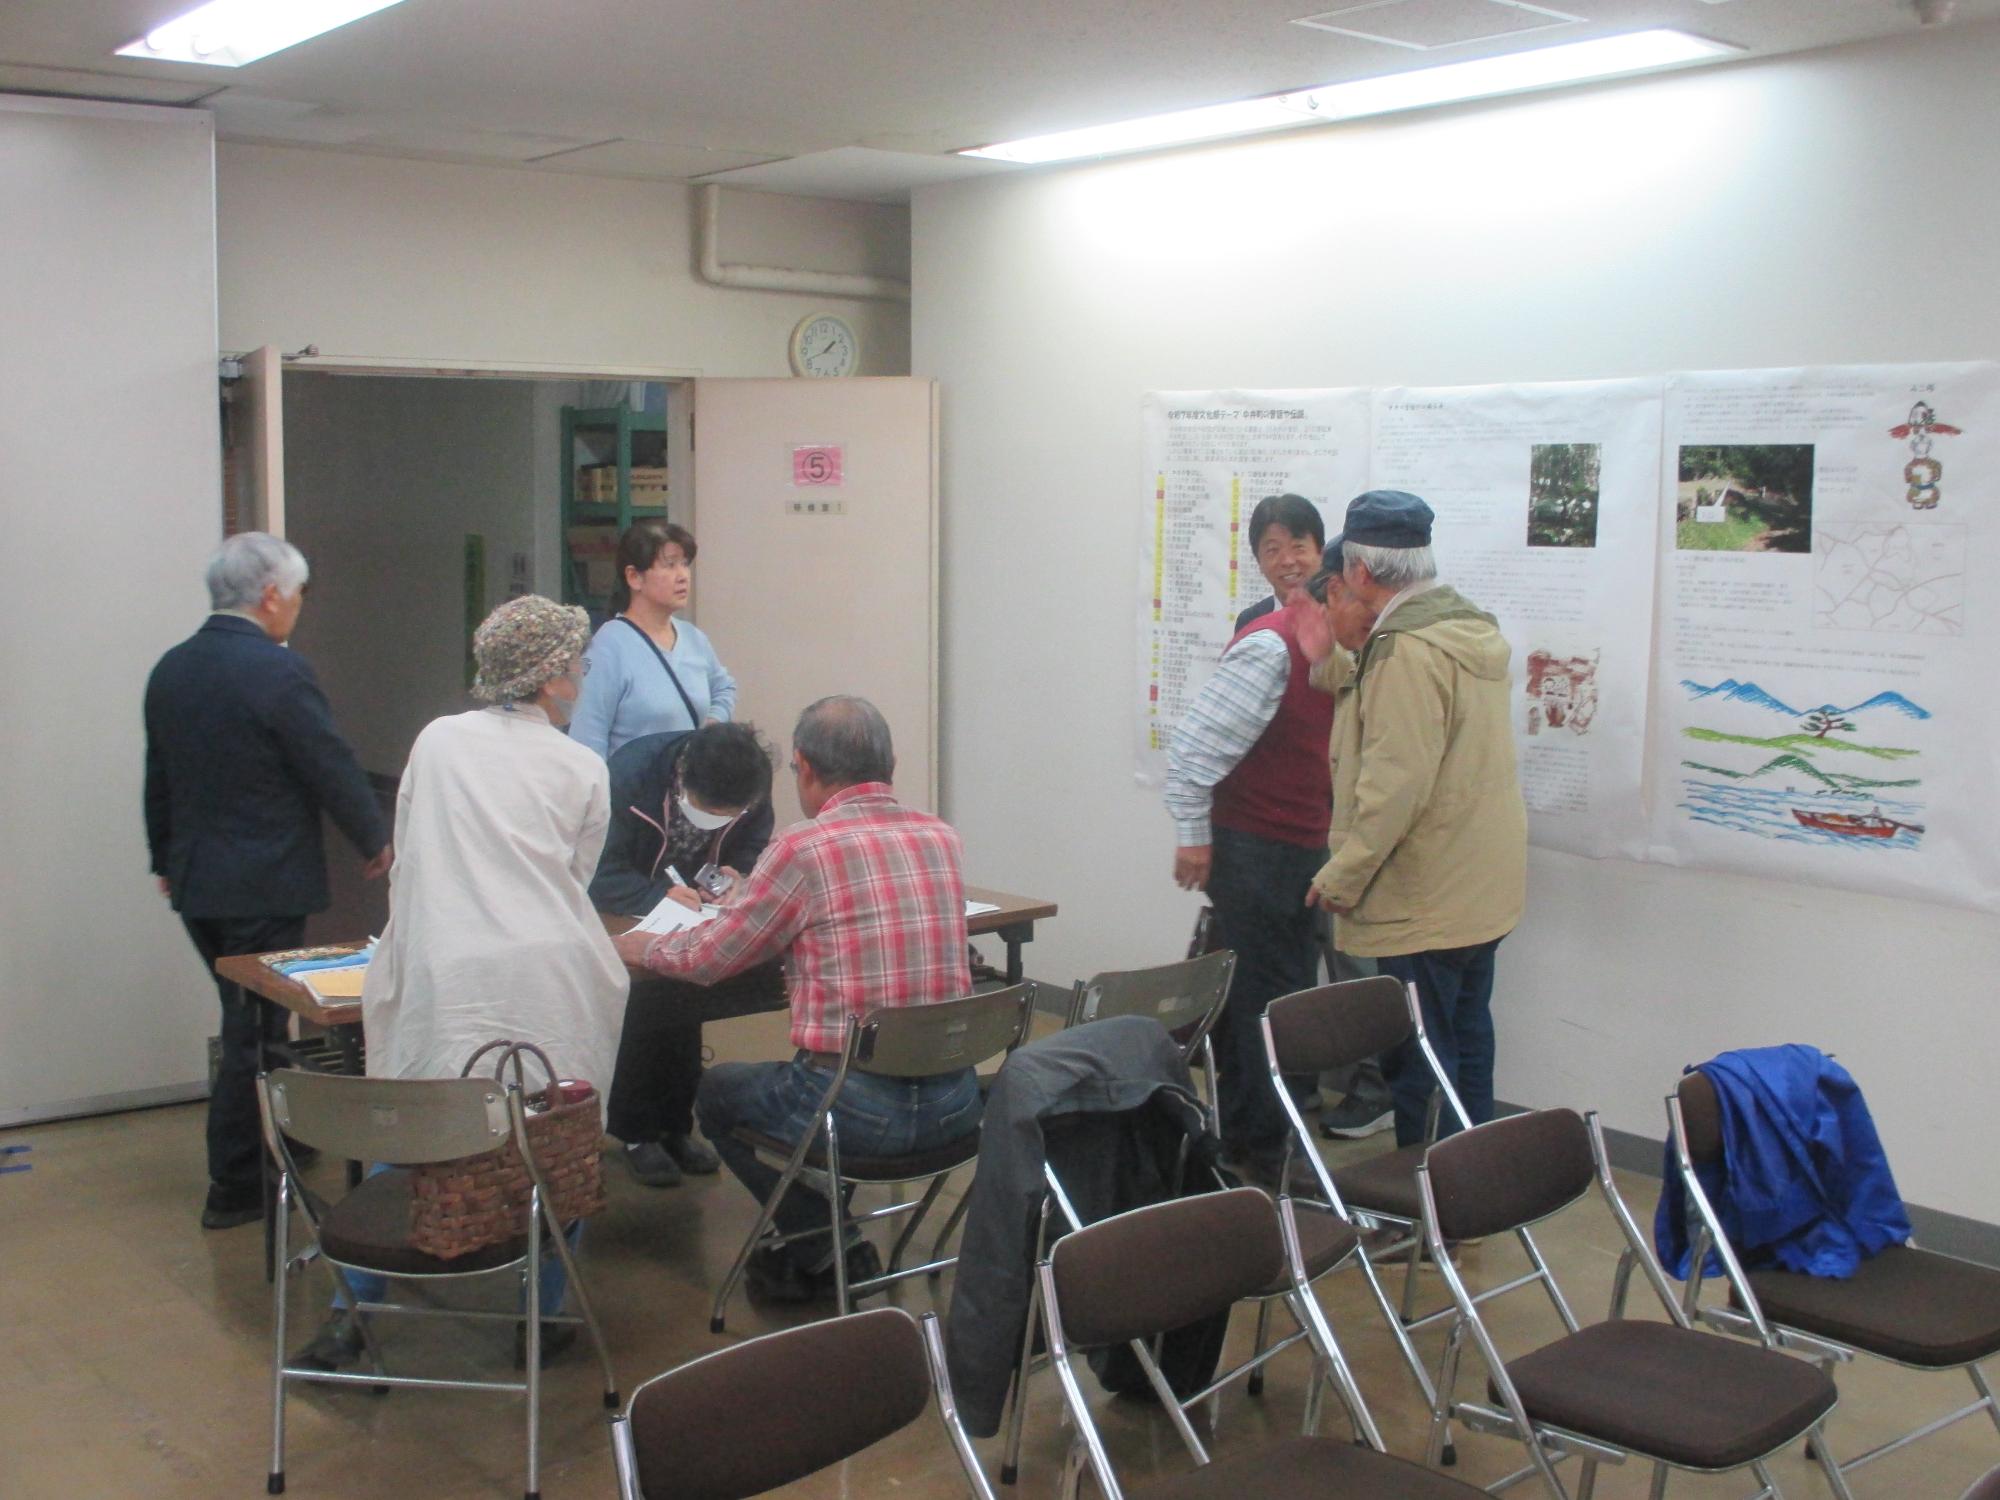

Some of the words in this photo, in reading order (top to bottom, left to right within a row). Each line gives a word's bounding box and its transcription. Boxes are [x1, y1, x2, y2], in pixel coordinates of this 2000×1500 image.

[820, 323, 828, 334] 12
[843, 345, 849, 356] 3
[807, 359, 813, 370] 8
